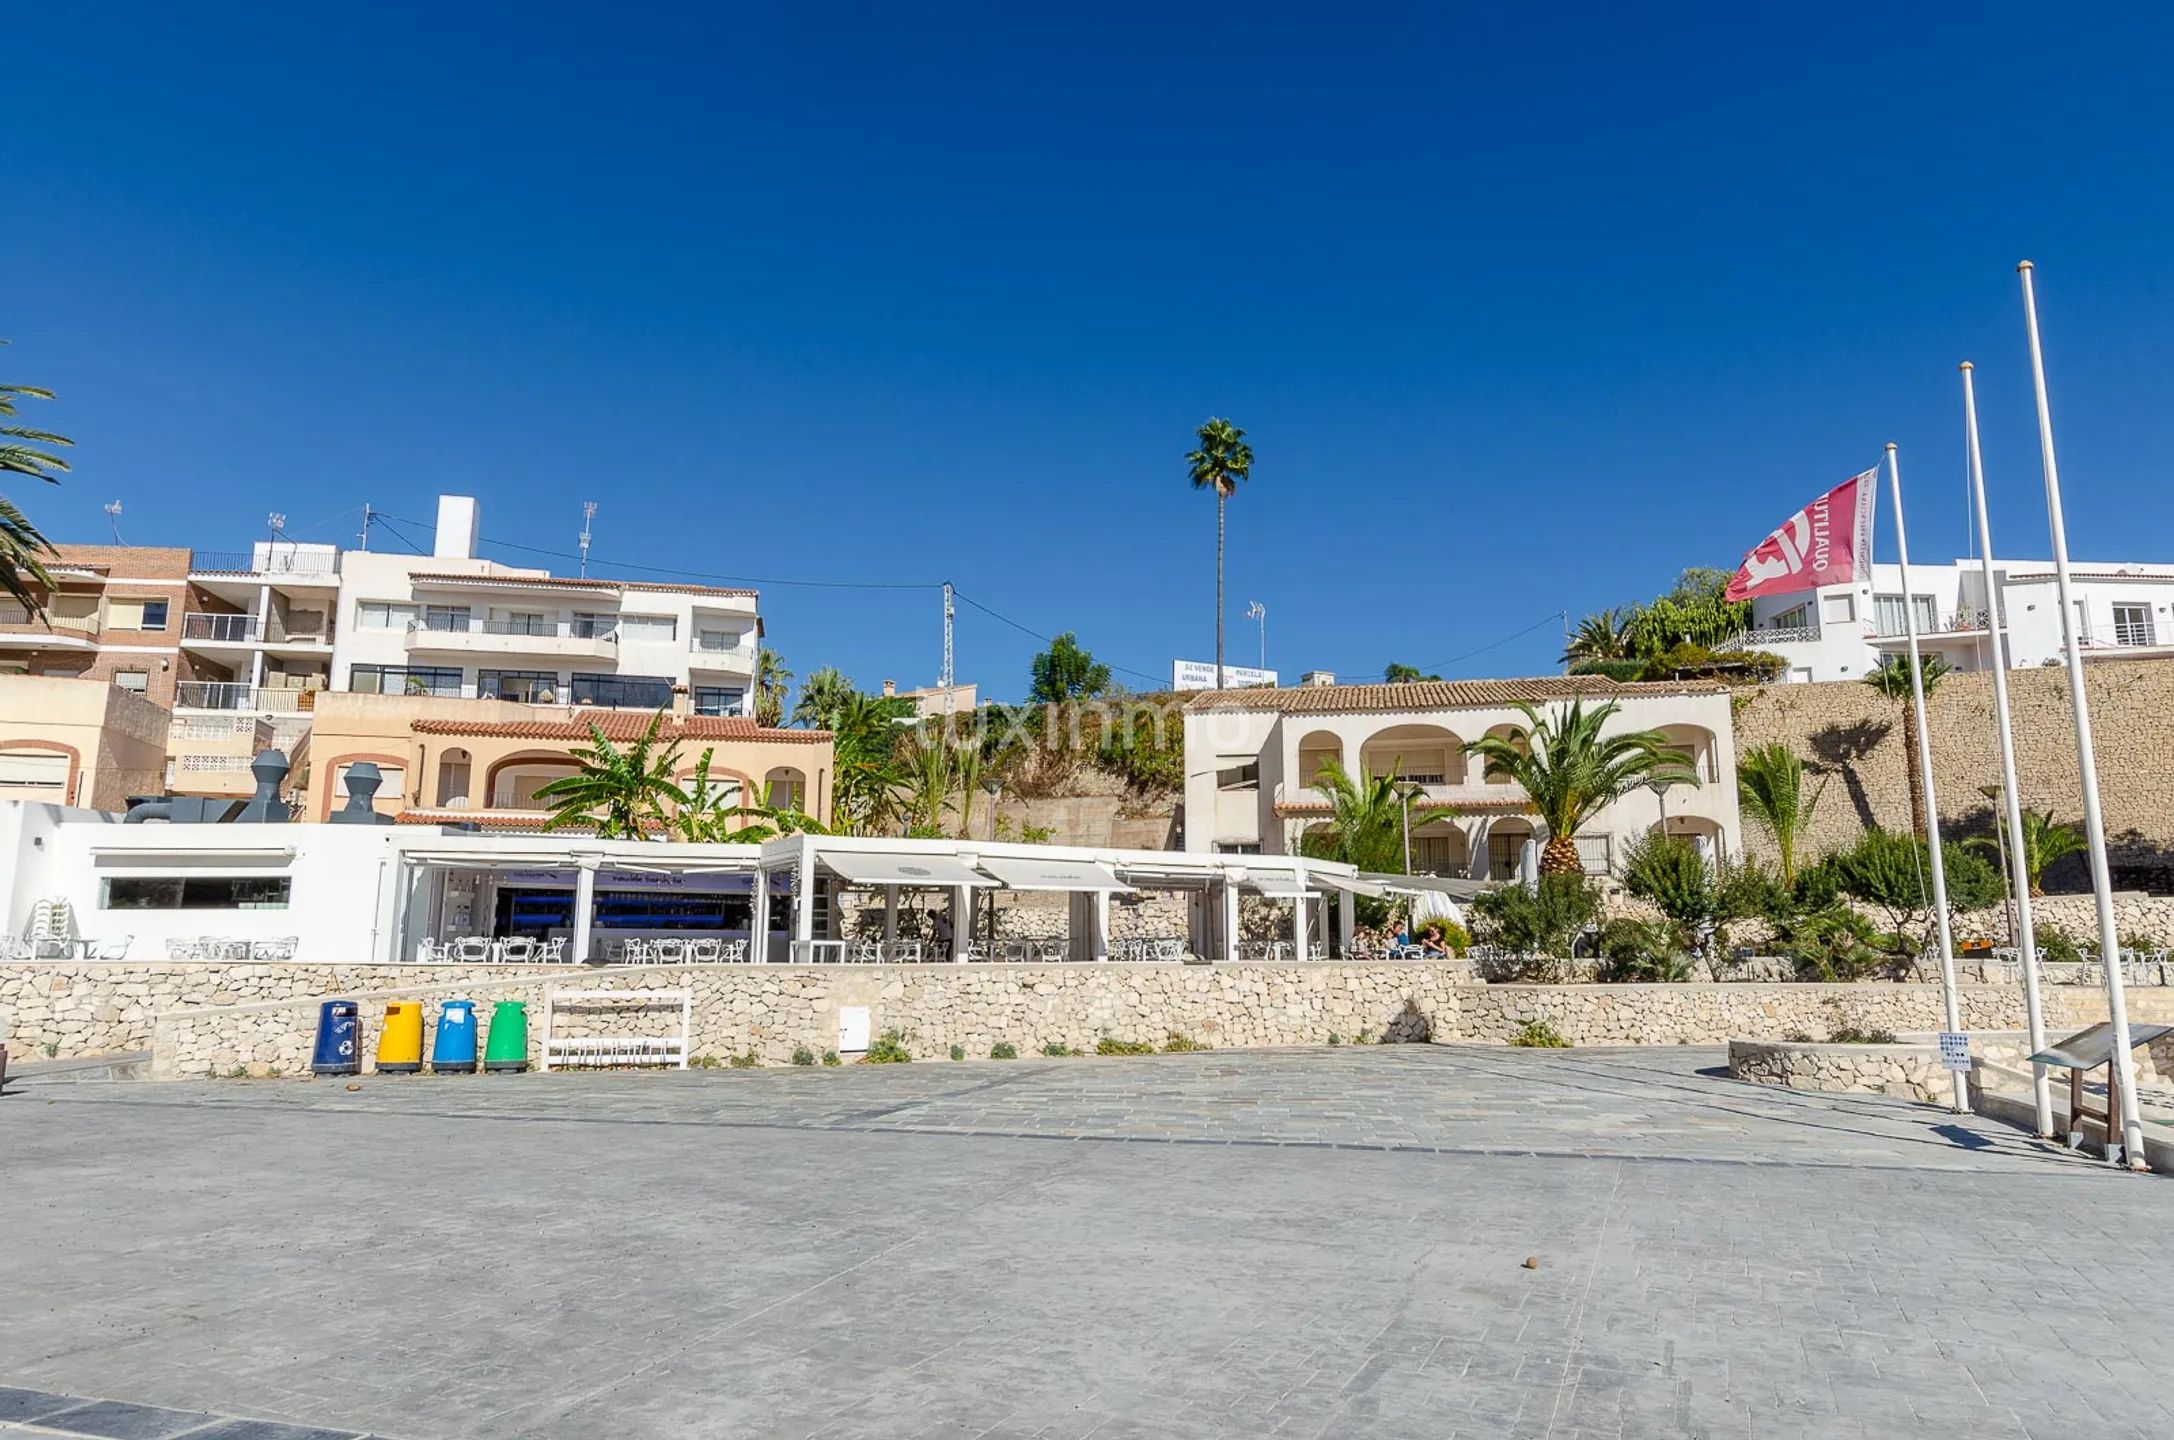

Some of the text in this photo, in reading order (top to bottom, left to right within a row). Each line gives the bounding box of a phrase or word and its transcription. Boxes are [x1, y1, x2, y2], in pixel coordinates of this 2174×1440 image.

[1194, 664, 1214, 673] VENDE
[1236, 669, 1262, 678] PARCELA
[1182, 673, 1207, 682] URBANA
